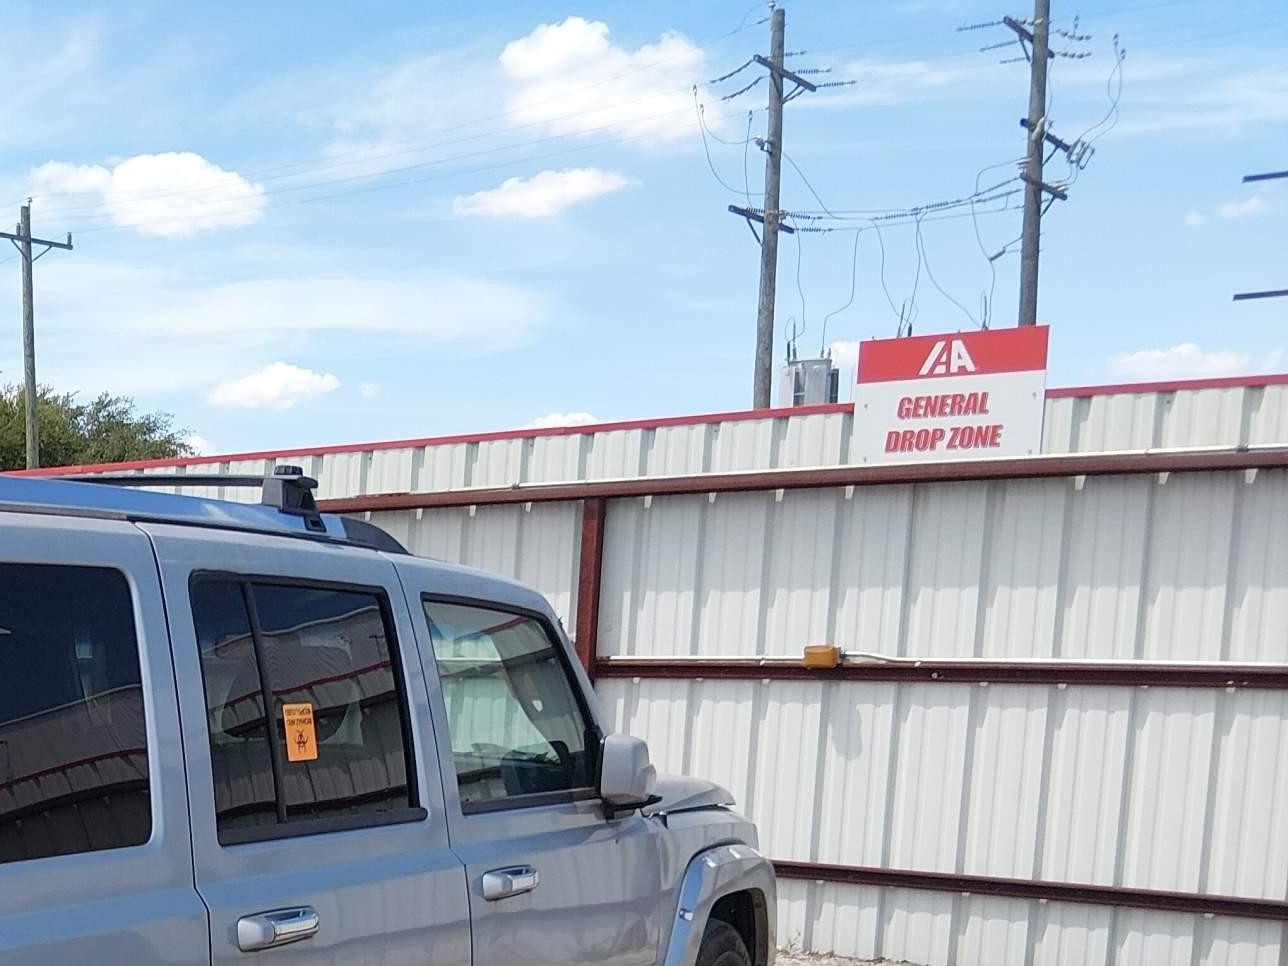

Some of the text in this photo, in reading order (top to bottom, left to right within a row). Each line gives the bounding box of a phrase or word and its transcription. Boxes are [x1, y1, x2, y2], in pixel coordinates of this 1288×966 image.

[897, 392, 989, 420] GENERAL
[884, 424, 1003, 453] DROP ZONE
